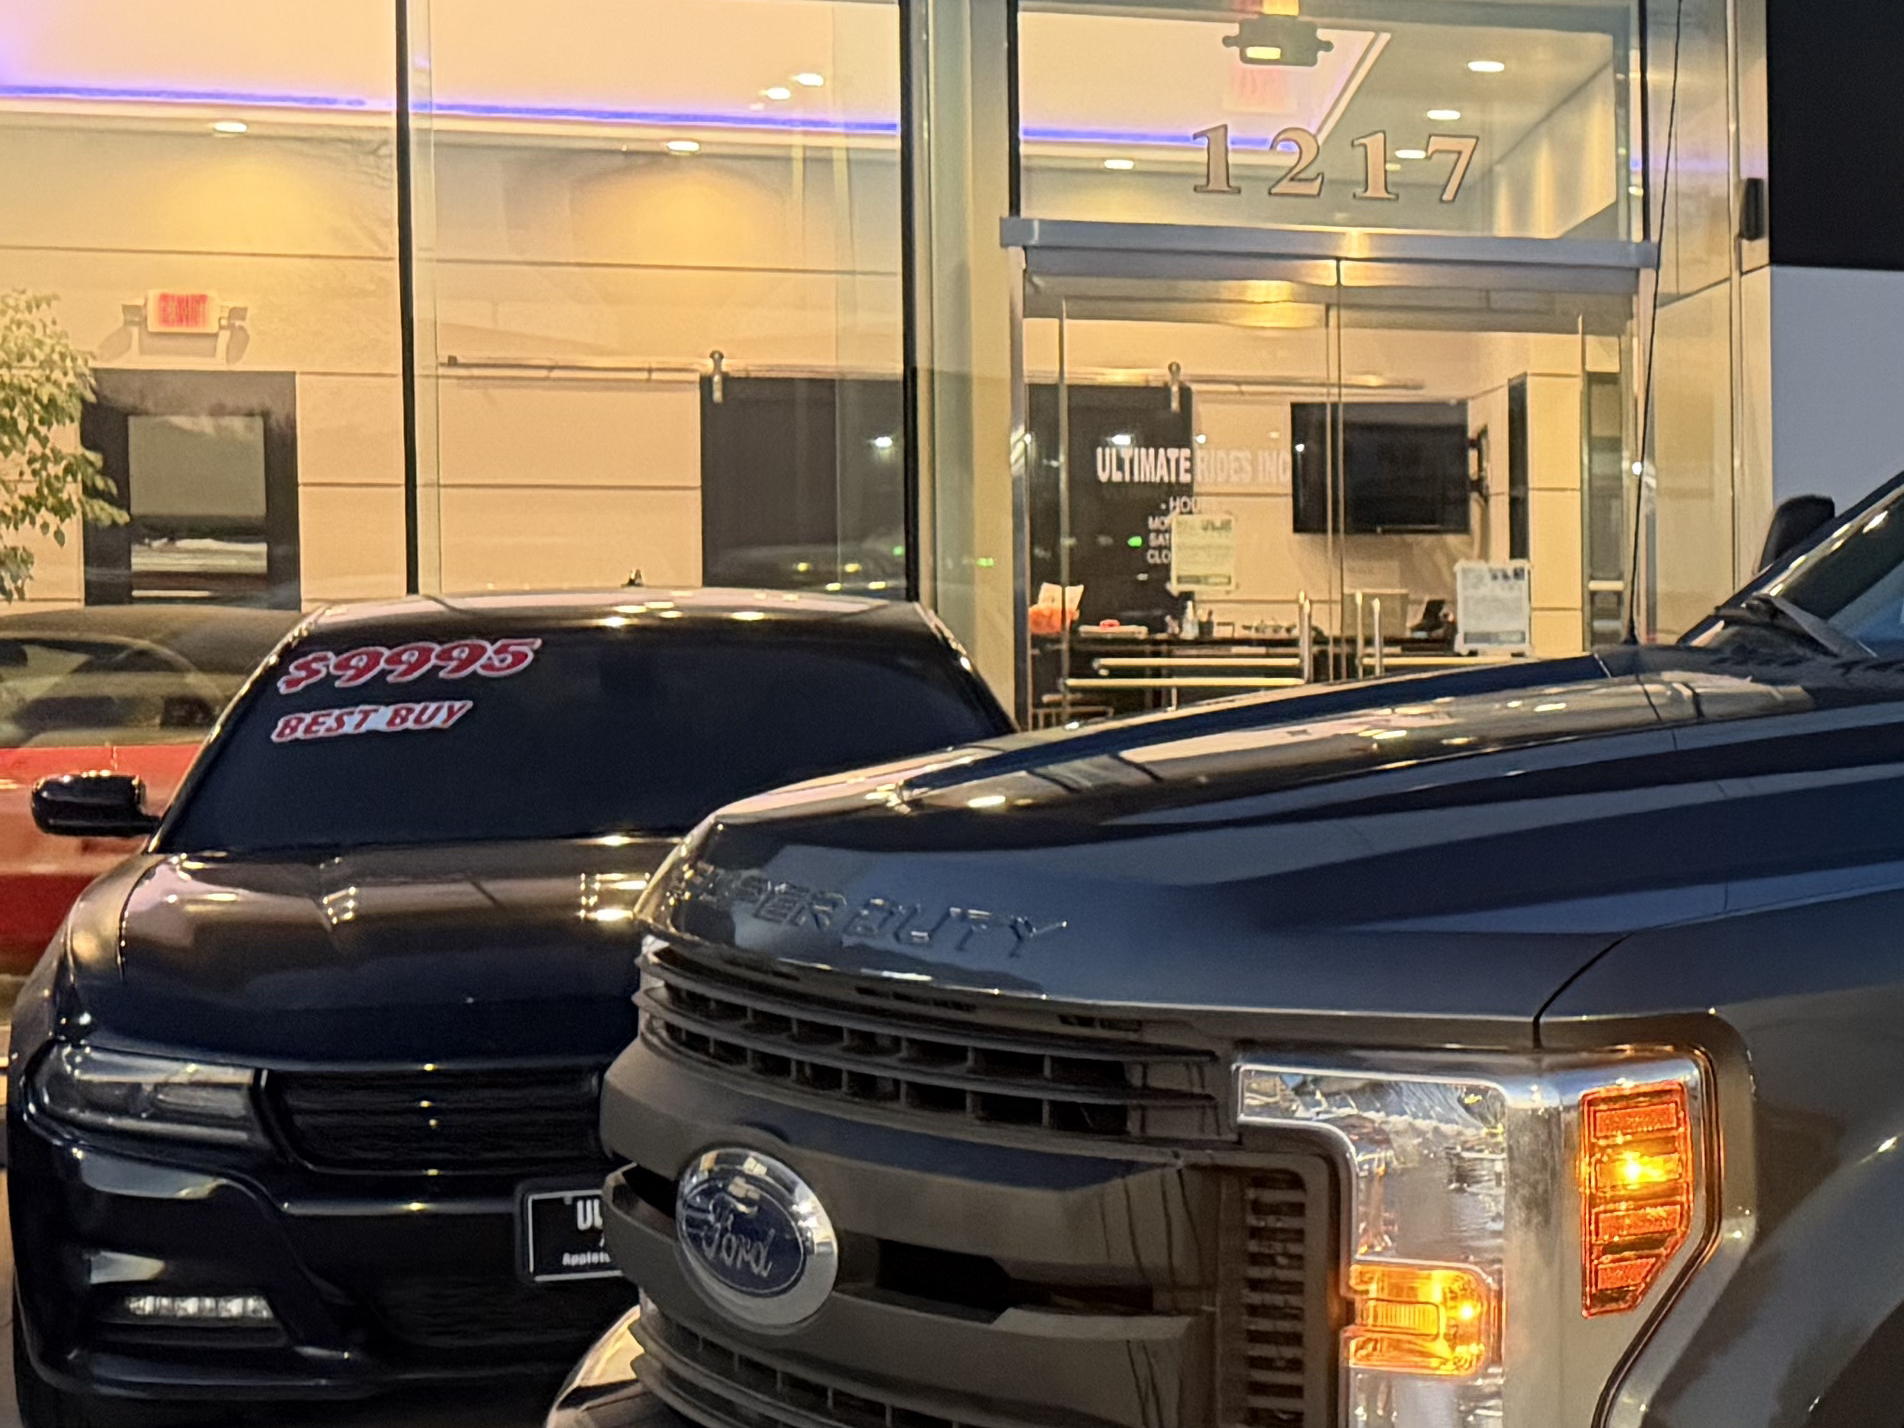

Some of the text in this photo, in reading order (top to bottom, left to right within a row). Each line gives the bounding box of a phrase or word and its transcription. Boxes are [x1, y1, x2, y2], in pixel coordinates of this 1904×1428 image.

[1192, 123, 1479, 203] 1217
[1096, 447, 1192, 483] ULTIMATE
[277, 637, 542, 695] $9995
[270, 700, 473, 743] BEST BUY
